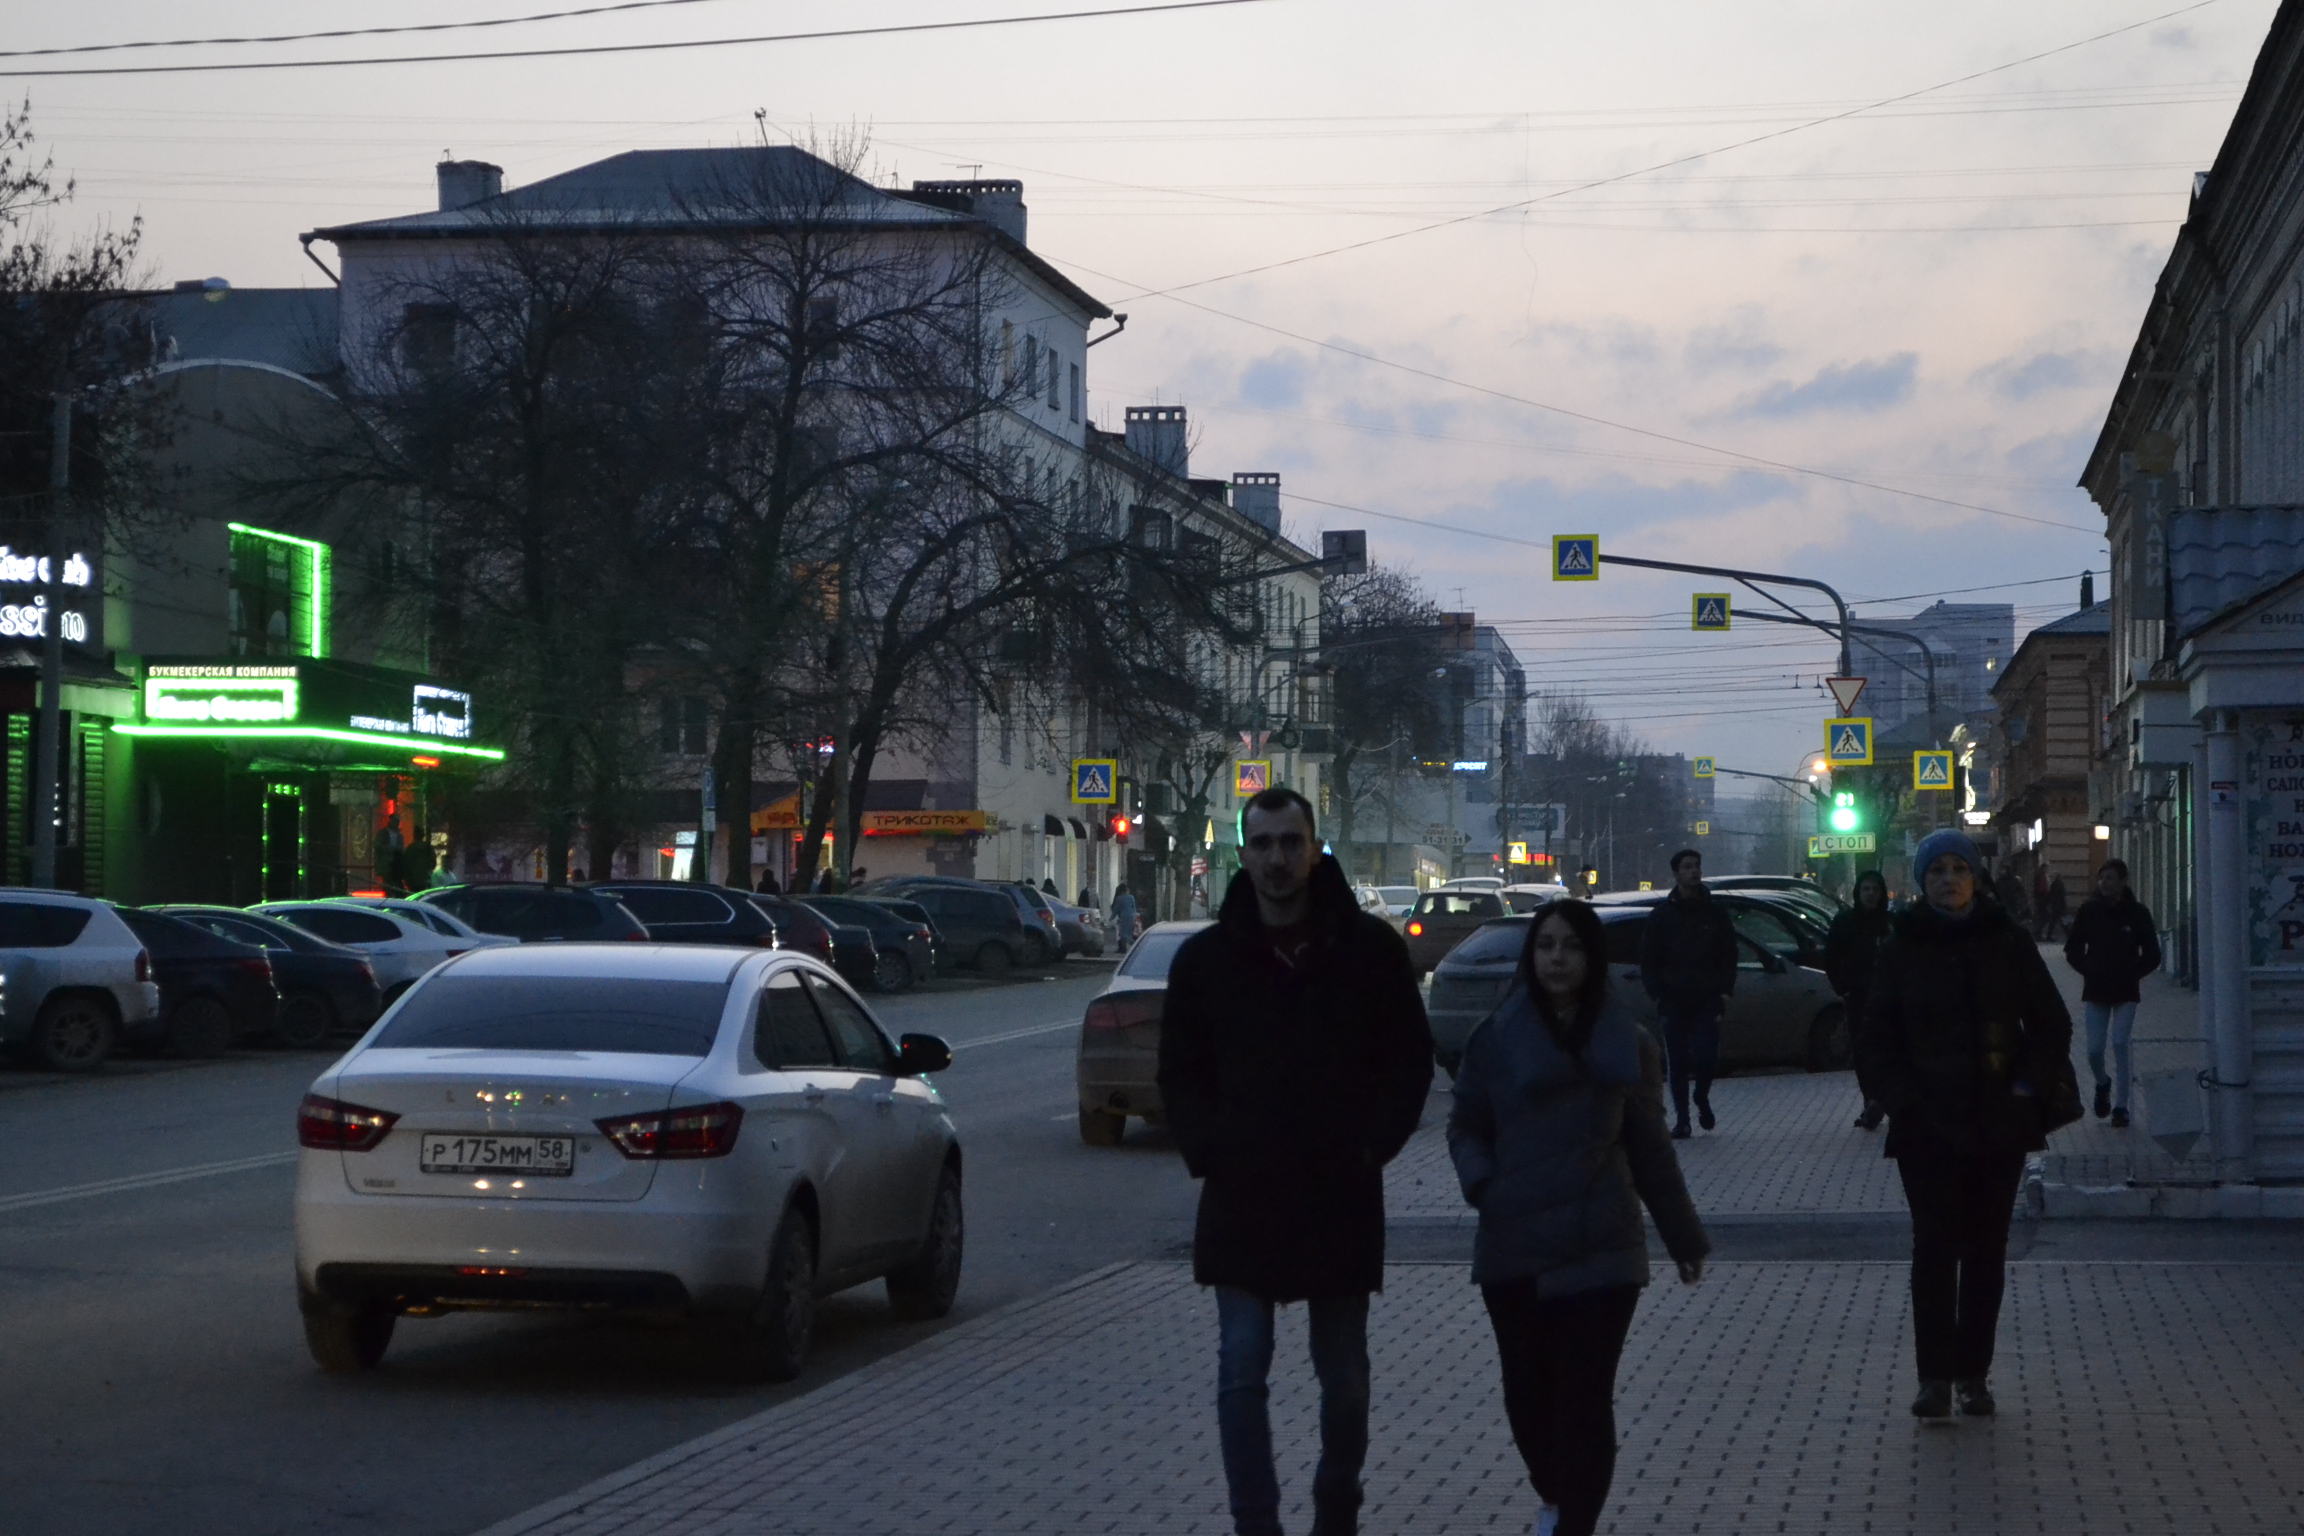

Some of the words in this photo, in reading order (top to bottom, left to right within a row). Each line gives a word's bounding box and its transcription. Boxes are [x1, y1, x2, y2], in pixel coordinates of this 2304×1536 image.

[2145, 478, 2164, 588] ТКАНИ
[149, 666, 233, 677] БУКМЕКЕРСКАЯ
[236, 666, 297, 677] КОМПАНИЯ
[1835, 792, 1855, 807] 21
[873, 814, 971, 826] ТРИКОТАЖ
[1422, 835, 1463, 844] 51-3131
[1825, 836, 1868, 849] СТОП
[538, 1139, 564, 1159] 58
